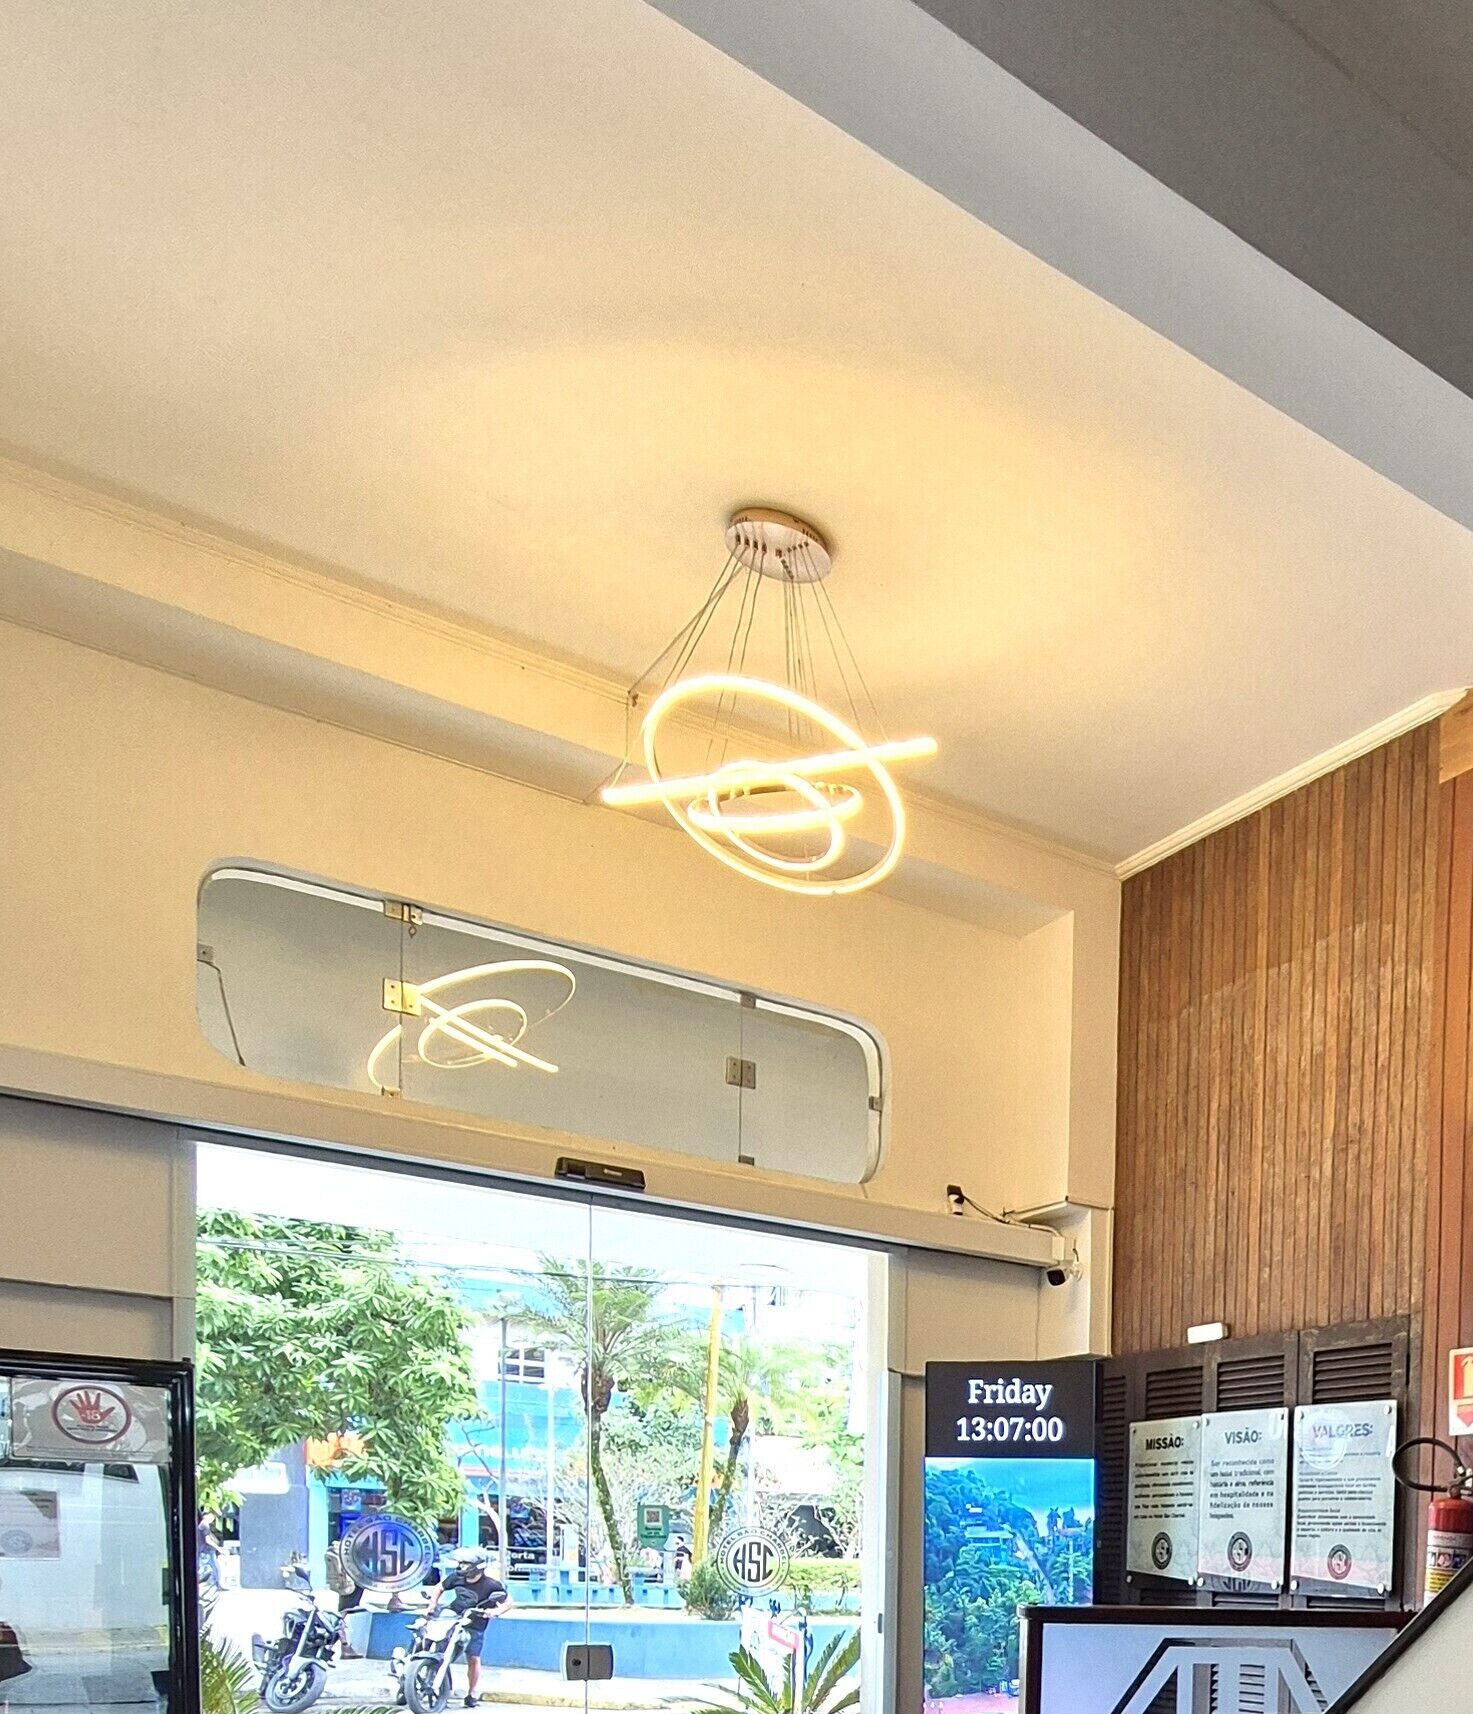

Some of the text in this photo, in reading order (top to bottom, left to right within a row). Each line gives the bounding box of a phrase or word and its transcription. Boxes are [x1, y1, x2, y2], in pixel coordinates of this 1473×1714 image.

[967, 1377, 1054, 1412] Friday
[956, 1416, 1064, 1442] 13:07:00
[1145, 1432, 1184, 1451] MISSÃO:
[1225, 1427, 1263, 1445] VISÃO:
[733, 1541, 774, 1583] HSC
